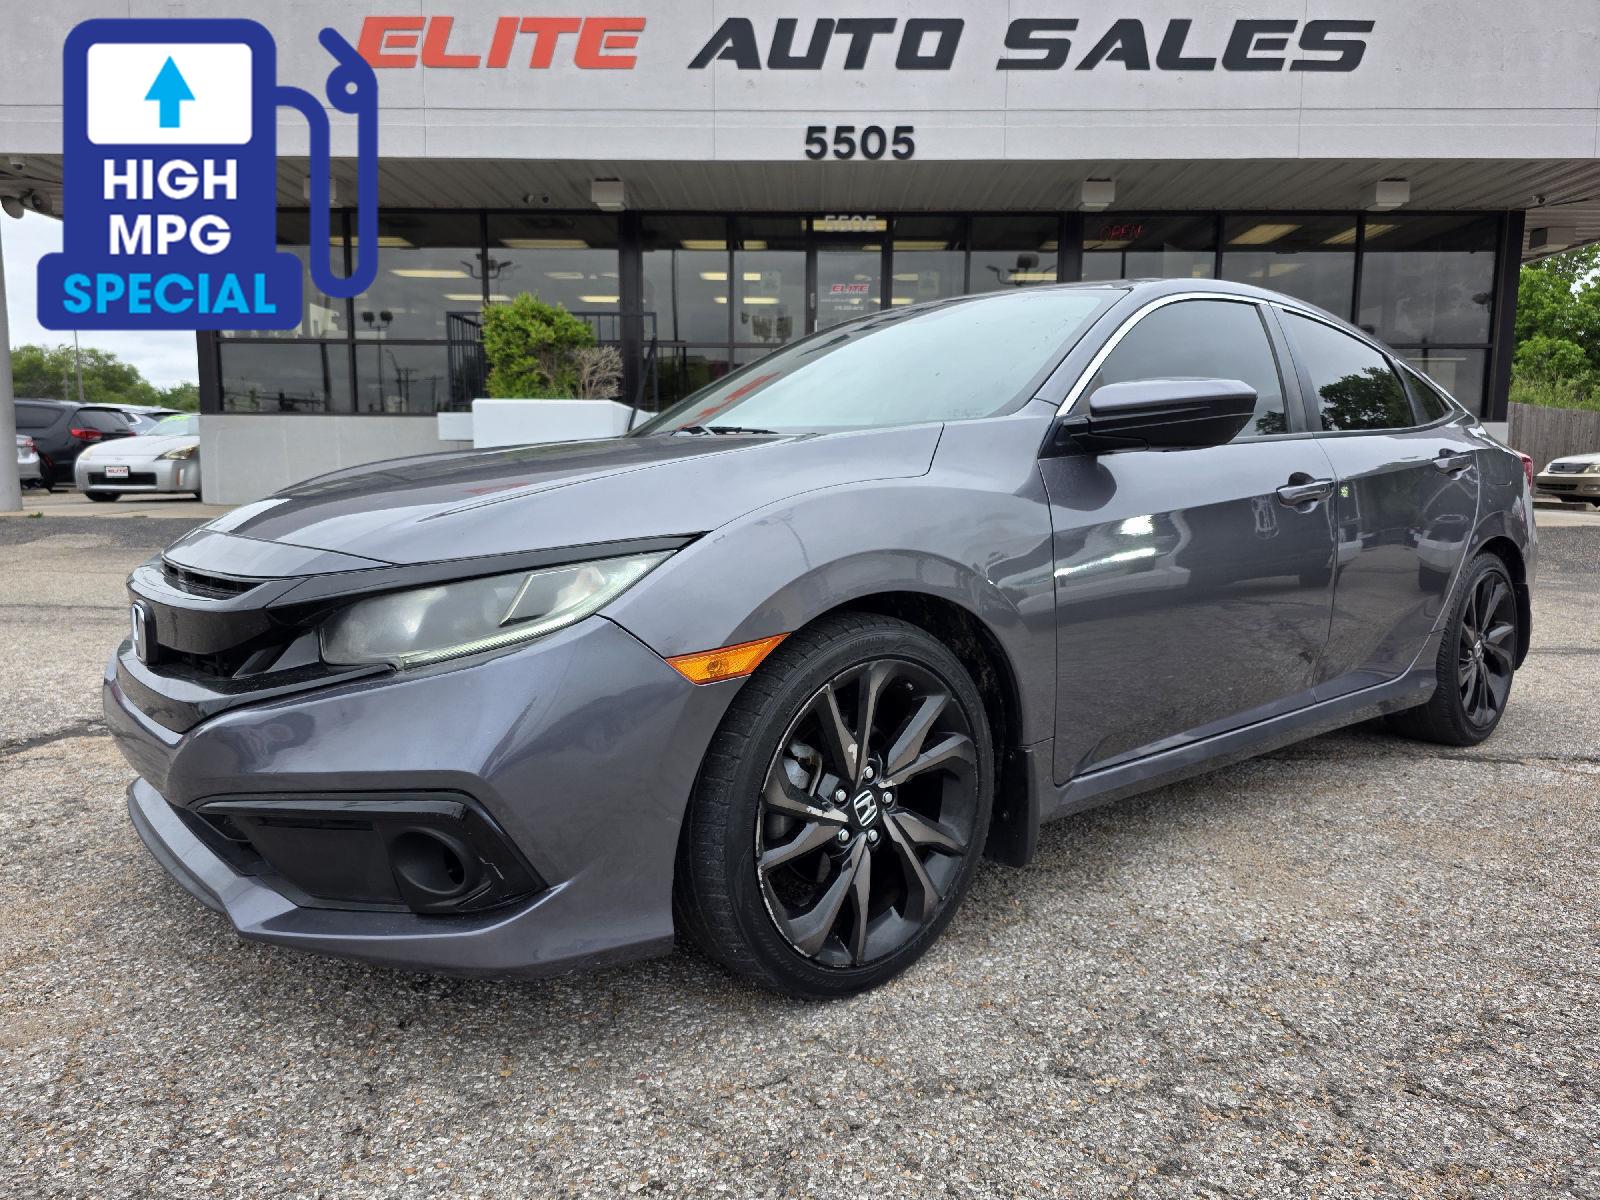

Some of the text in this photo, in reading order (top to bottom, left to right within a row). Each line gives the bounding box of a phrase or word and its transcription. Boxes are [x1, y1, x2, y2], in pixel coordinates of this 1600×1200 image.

[357, 16, 1376, 72] ELITE AUTO SALES
[804, 125, 916, 161] 5505
[824, 215, 877, 232] 5505
[1101, 224, 1143, 241] OPEN
[832, 284, 870, 295] ELITE
